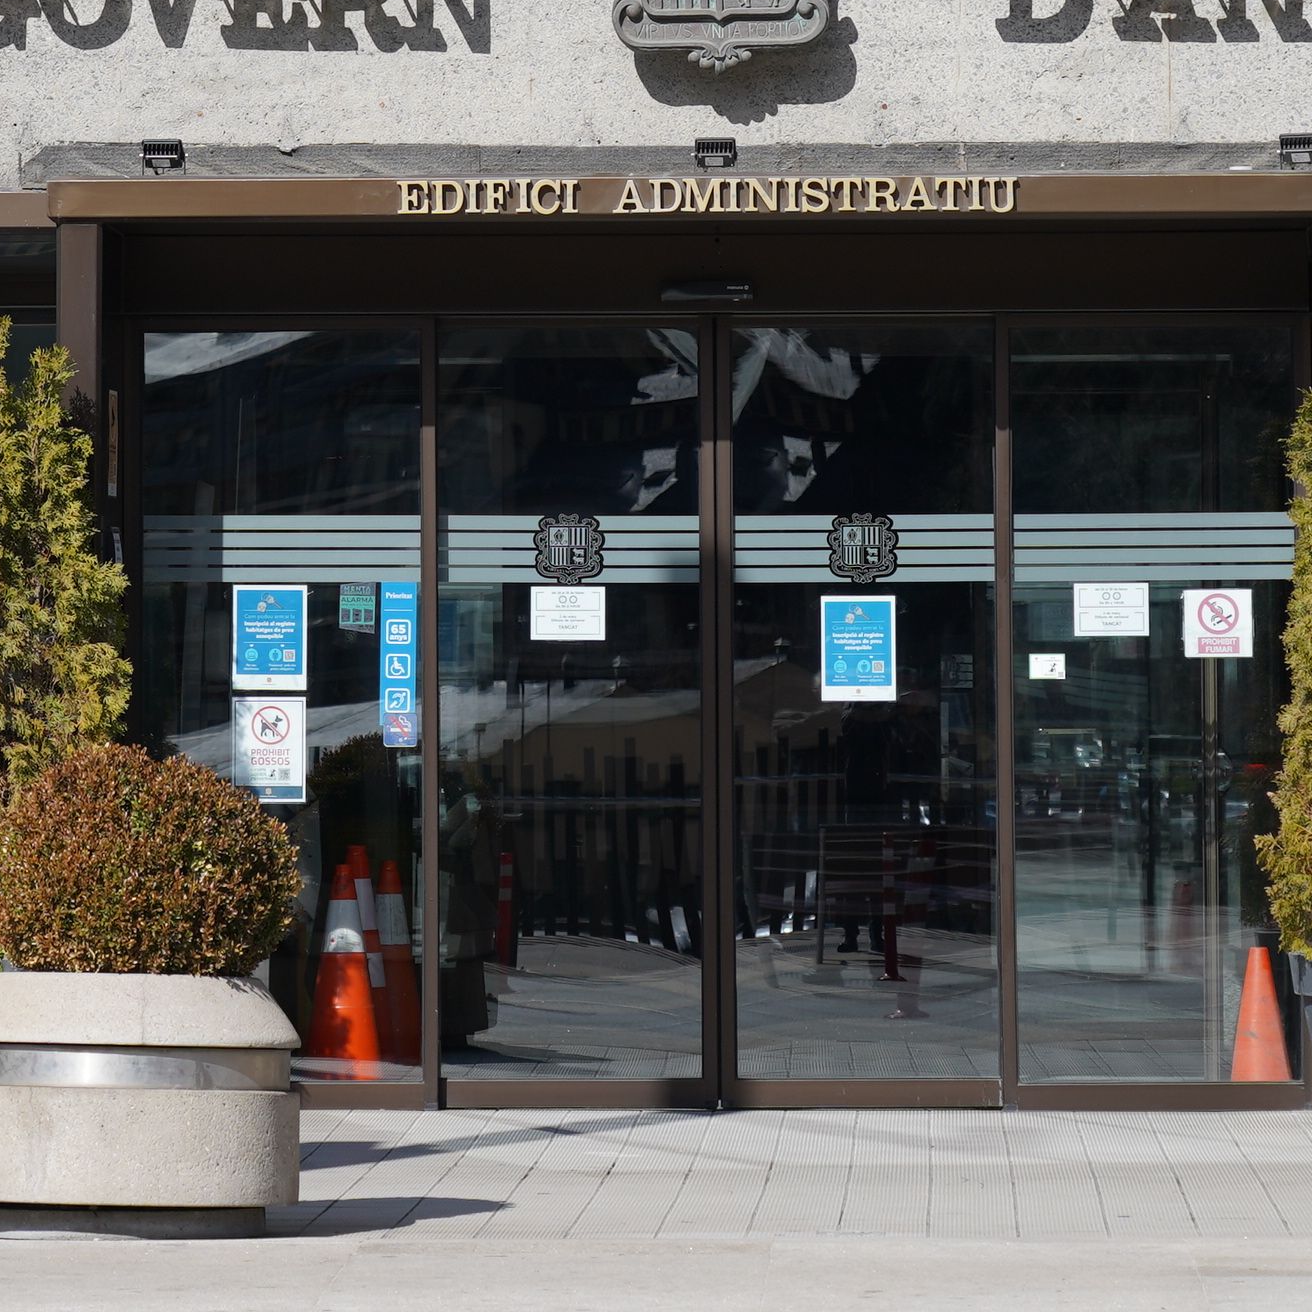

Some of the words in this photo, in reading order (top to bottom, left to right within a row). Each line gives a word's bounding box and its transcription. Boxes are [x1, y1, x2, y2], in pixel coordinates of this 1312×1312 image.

[397, 179, 580, 215] EDIFICI
[613, 176, 1018, 214] ADMINISTRATIU
[390, 624, 406, 634] 65
[250, 748, 290, 756] PROHIBIT
[250, 757, 290, 765] GOSSOS
